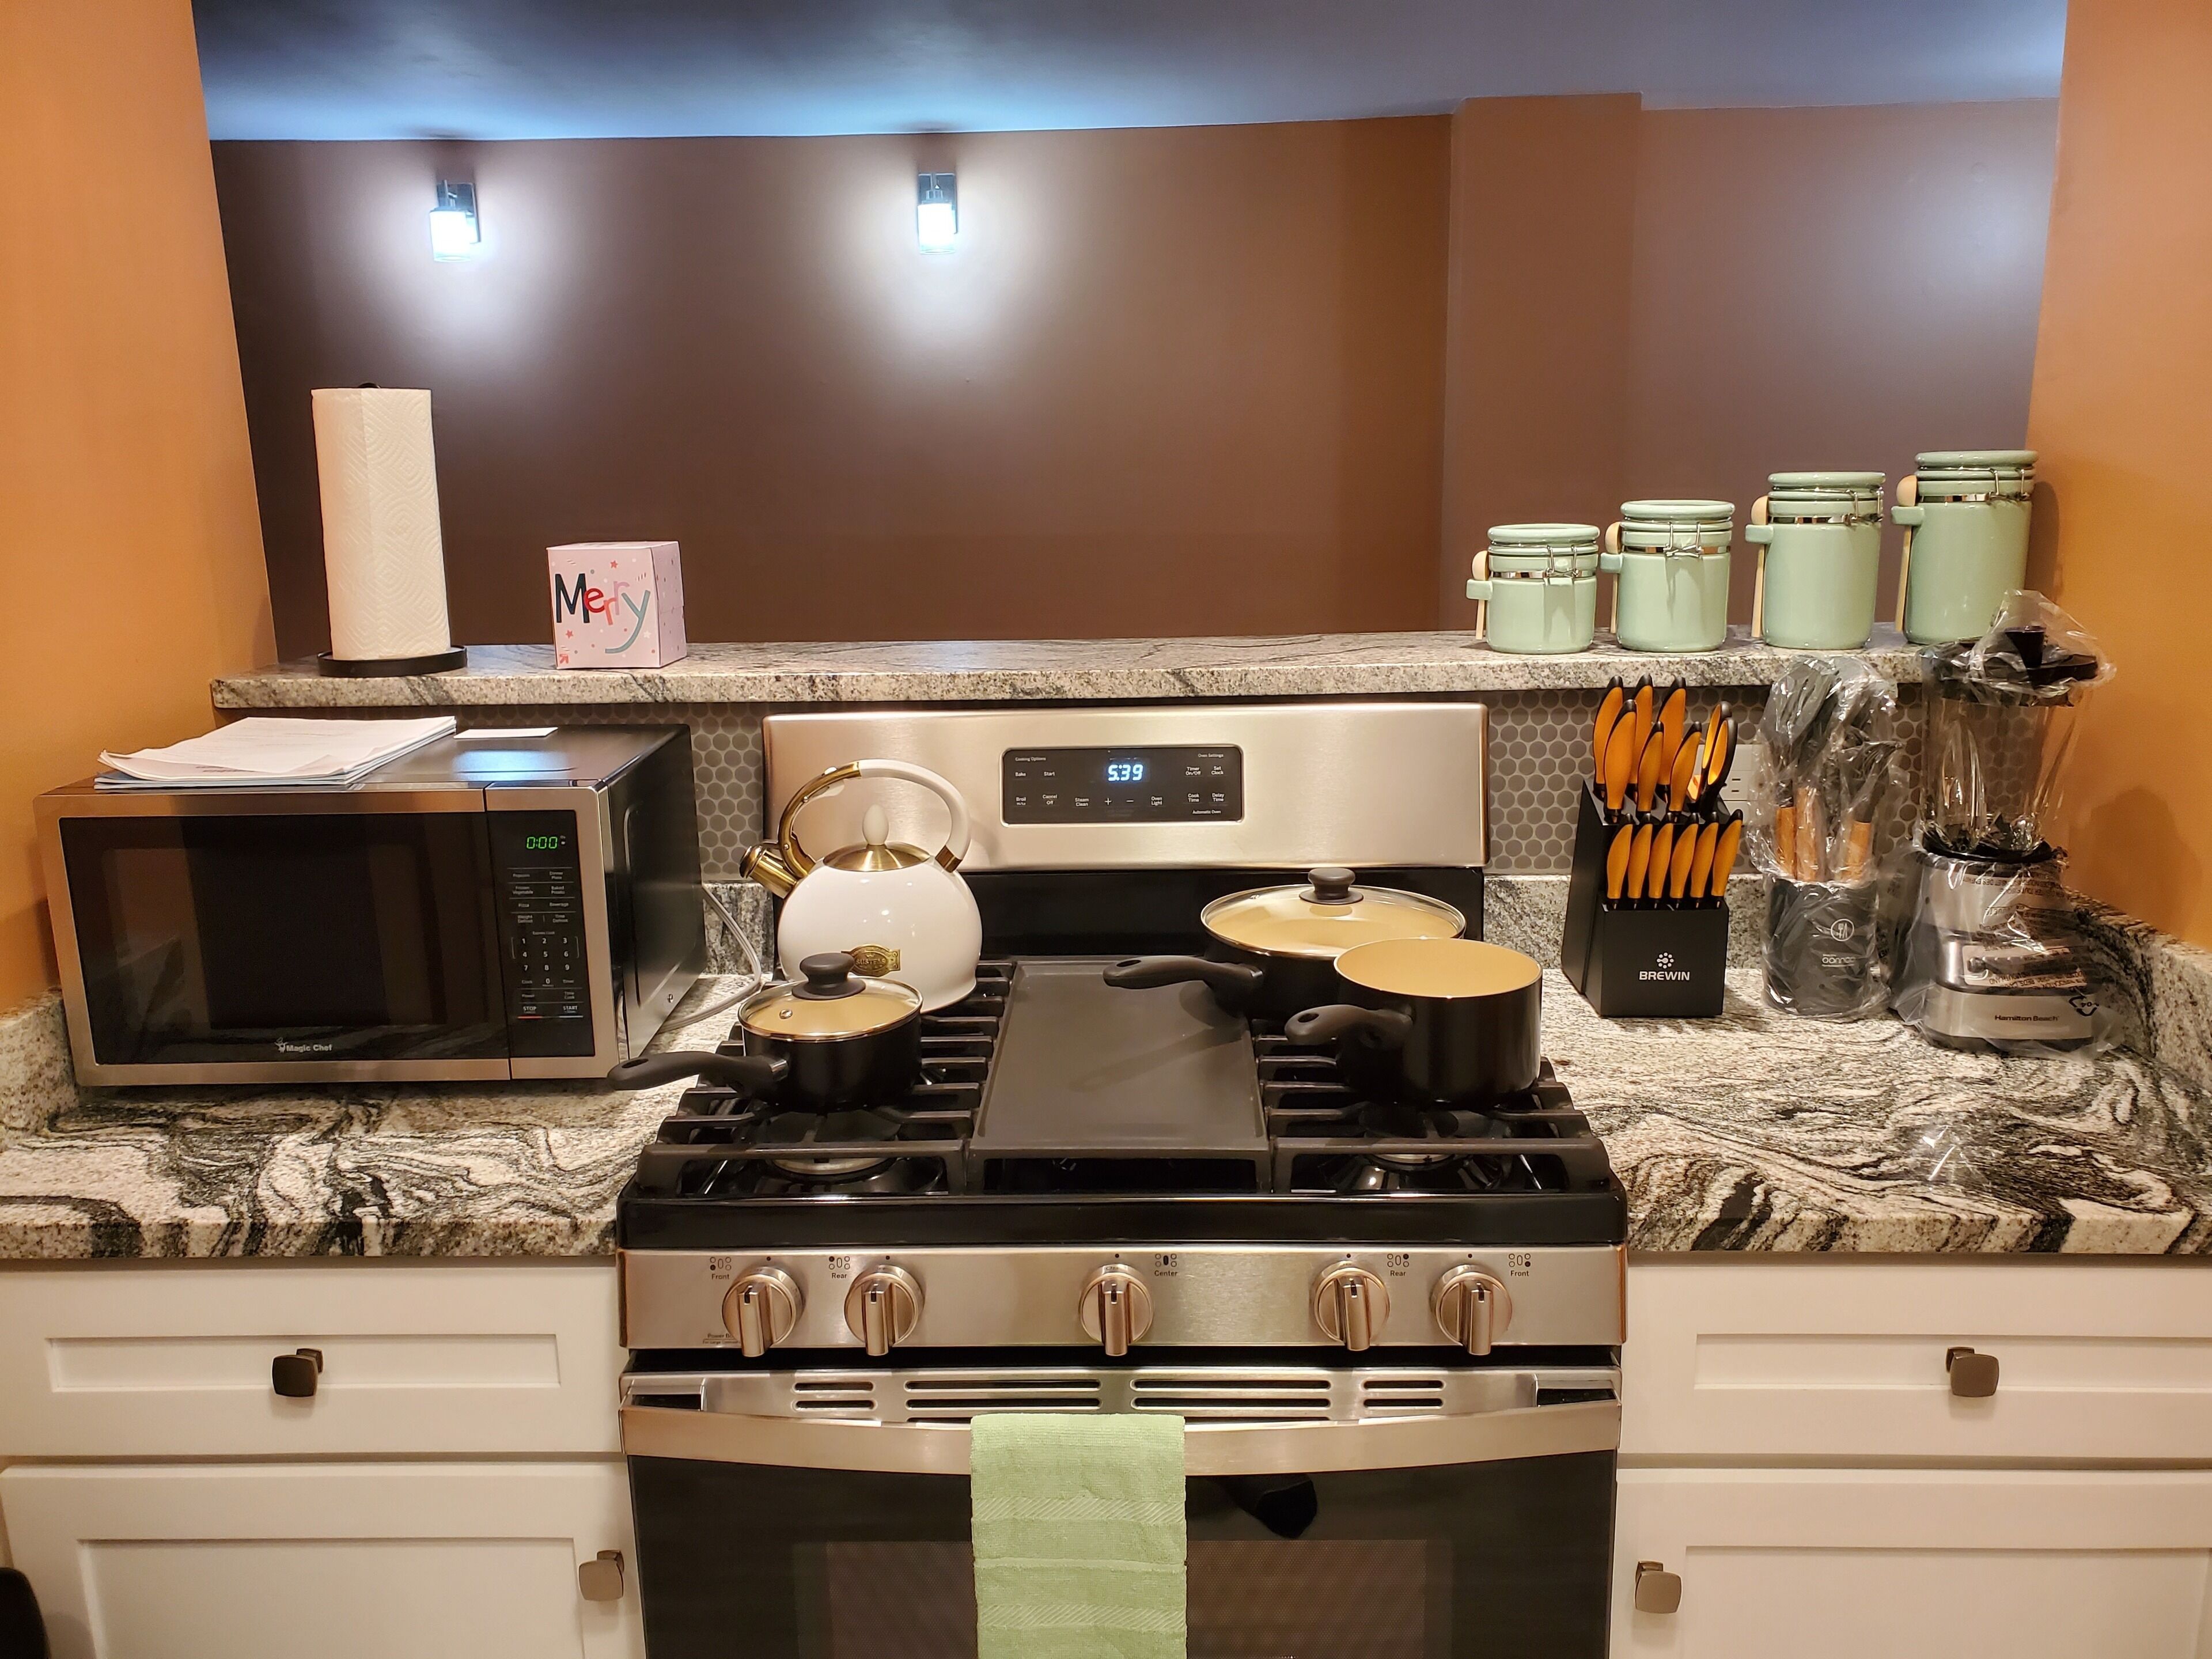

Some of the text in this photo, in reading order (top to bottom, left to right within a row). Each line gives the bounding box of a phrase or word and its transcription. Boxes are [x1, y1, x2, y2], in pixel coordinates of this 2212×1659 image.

[555, 573, 651, 654] Merry
[1108, 764, 1143, 781] 5:39
[526, 836, 558, 850] 0:00
[1639, 971, 1690, 980] BREWIN
[286, 1044, 311, 1053] Magic
